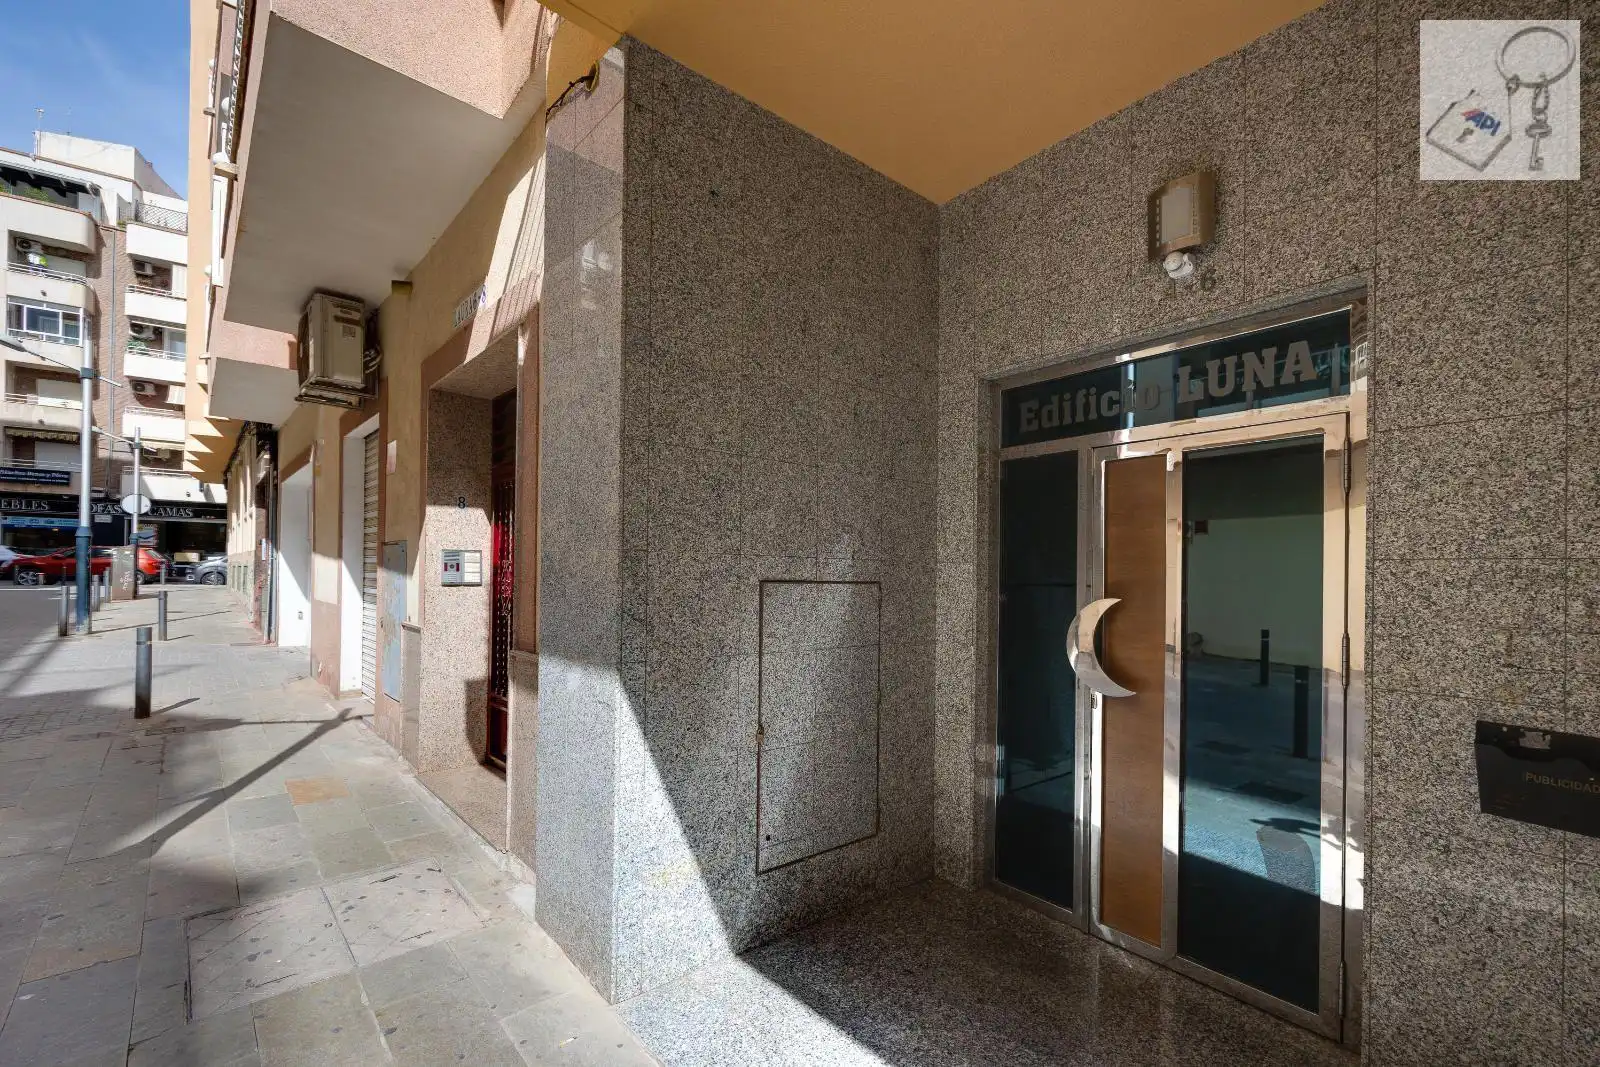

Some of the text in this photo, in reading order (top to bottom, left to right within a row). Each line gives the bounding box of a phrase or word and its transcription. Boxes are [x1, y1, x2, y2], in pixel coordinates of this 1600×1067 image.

[1019, 340, 1318, 433] Edificio LUNA
[458, 496, 466, 509] 8
[148, 507, 194, 518] CAMAS
